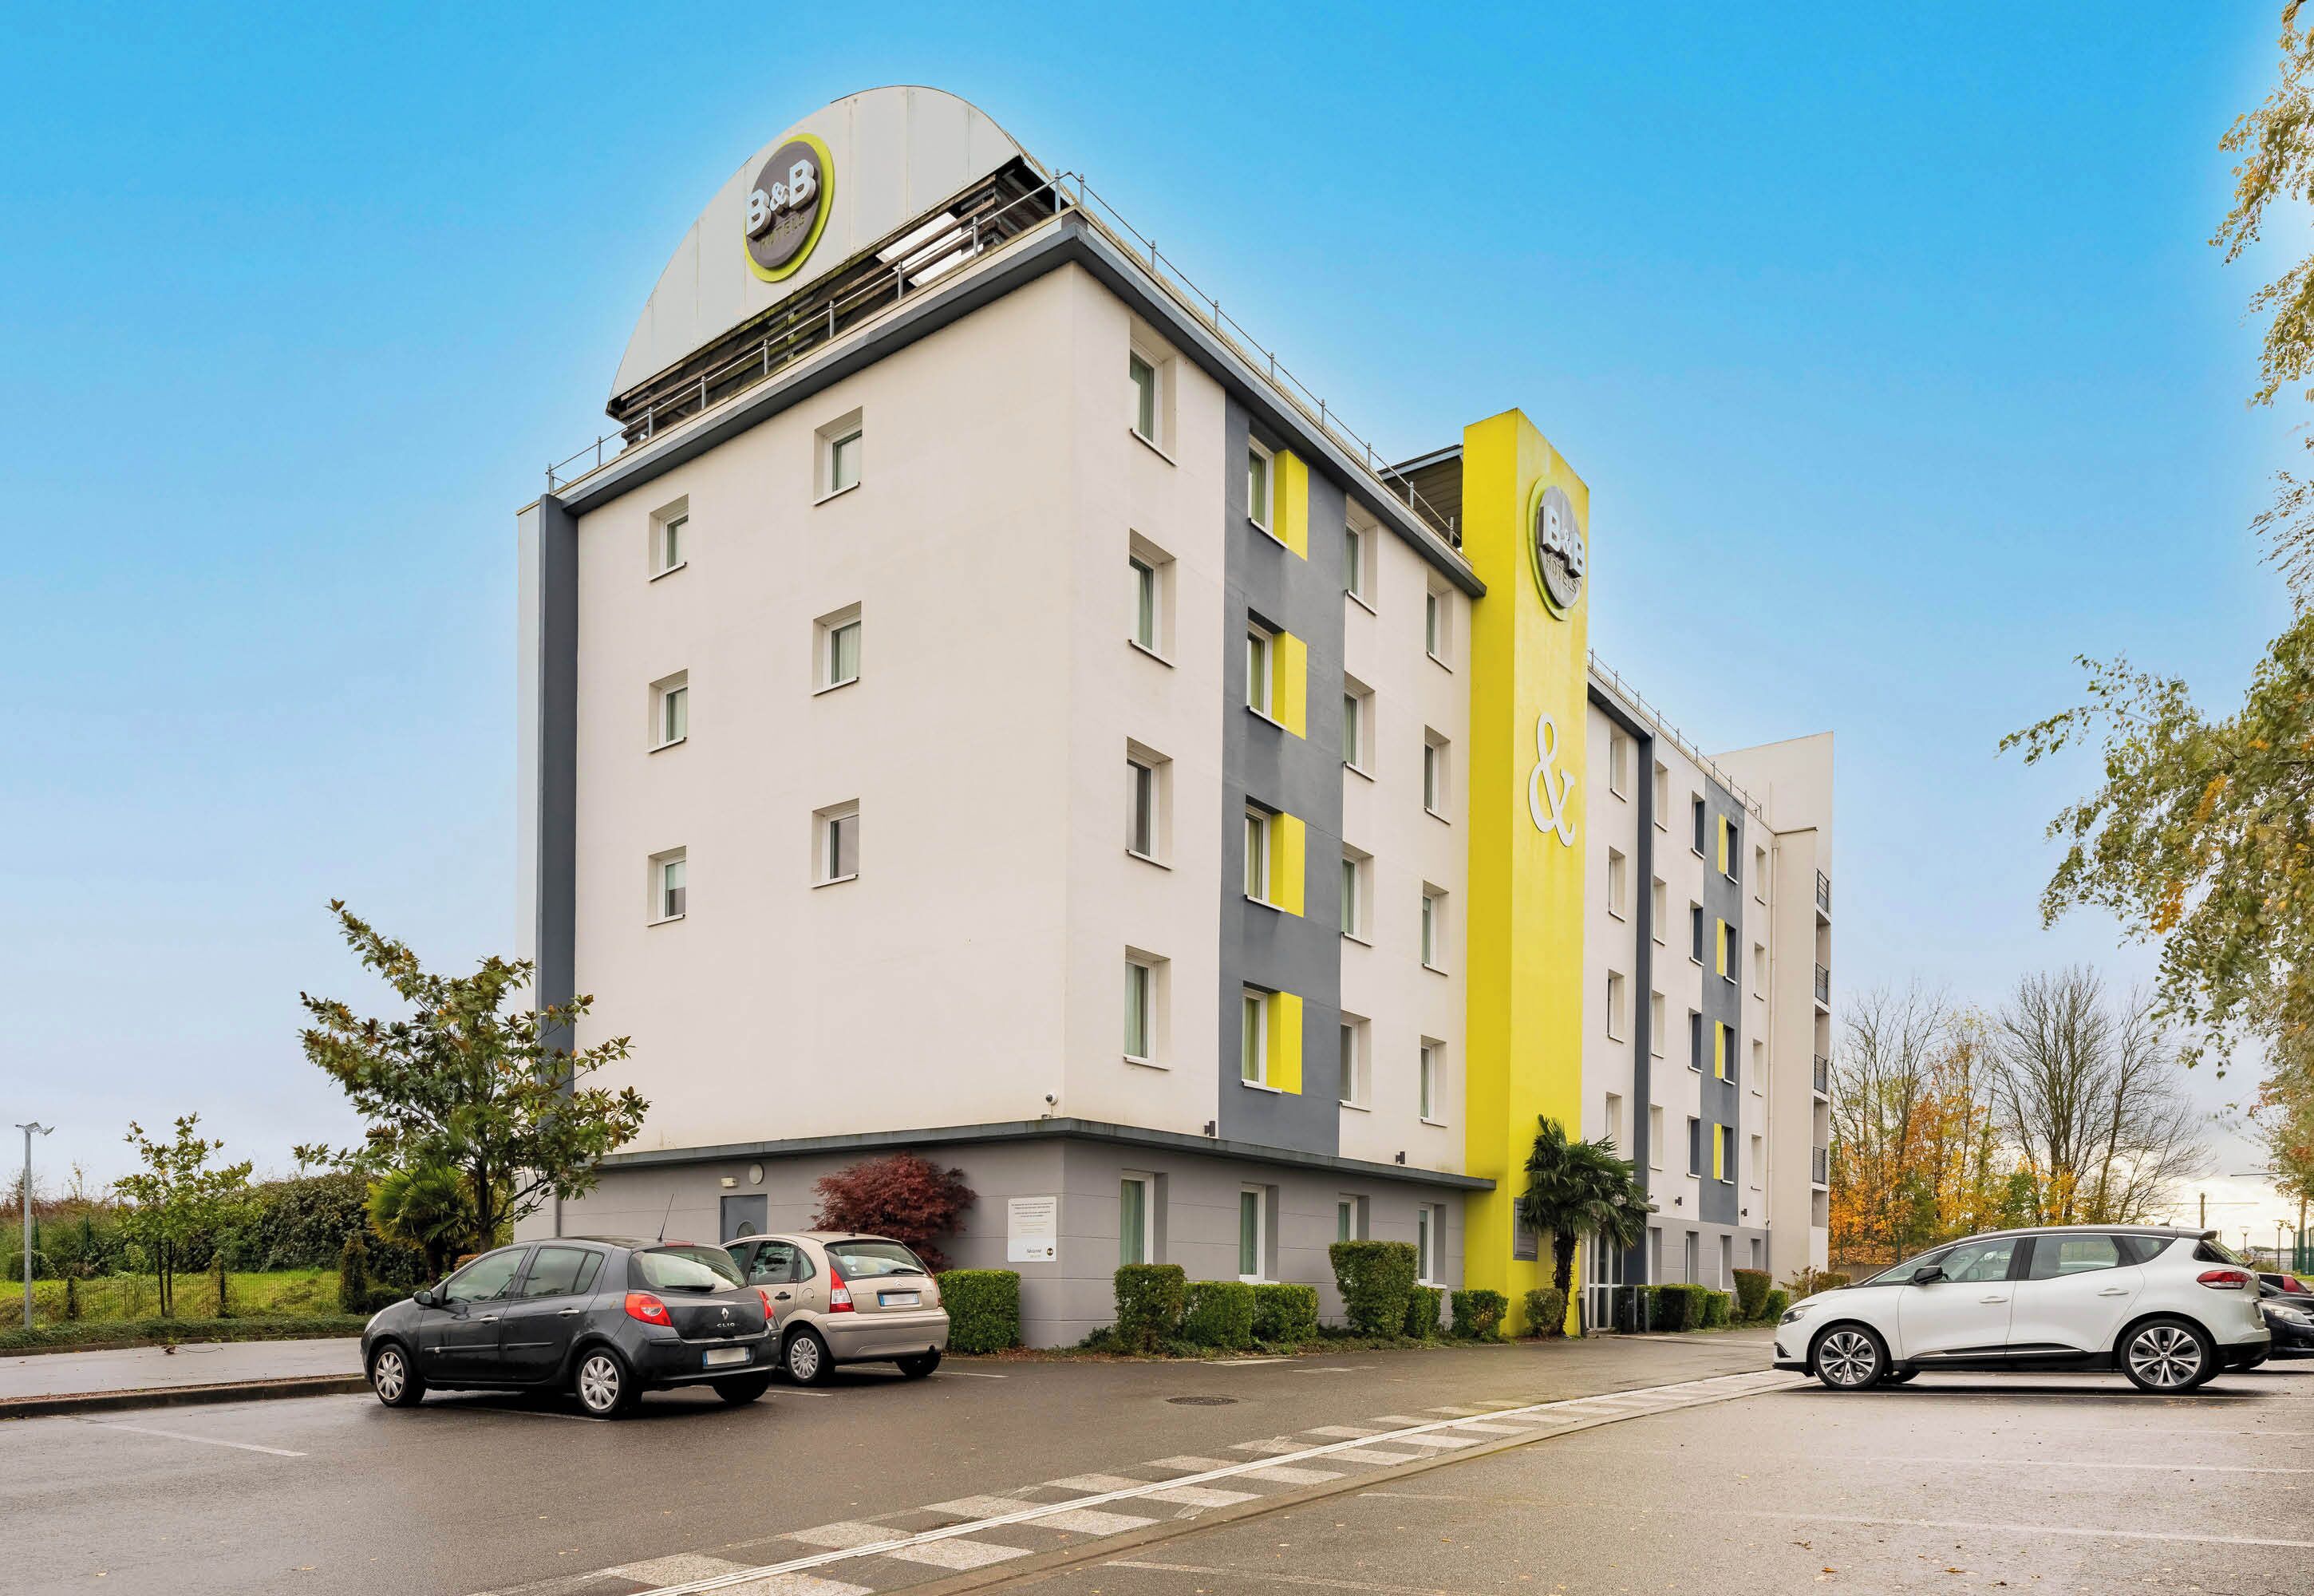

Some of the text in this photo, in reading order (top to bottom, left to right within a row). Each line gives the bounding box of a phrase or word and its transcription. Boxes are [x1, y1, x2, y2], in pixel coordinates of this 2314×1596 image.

[746, 160, 816, 238] B&B
[1540, 505, 1585, 577] B&B
[1546, 554, 1577, 595] HOTELS
[1528, 712, 1576, 847] &
